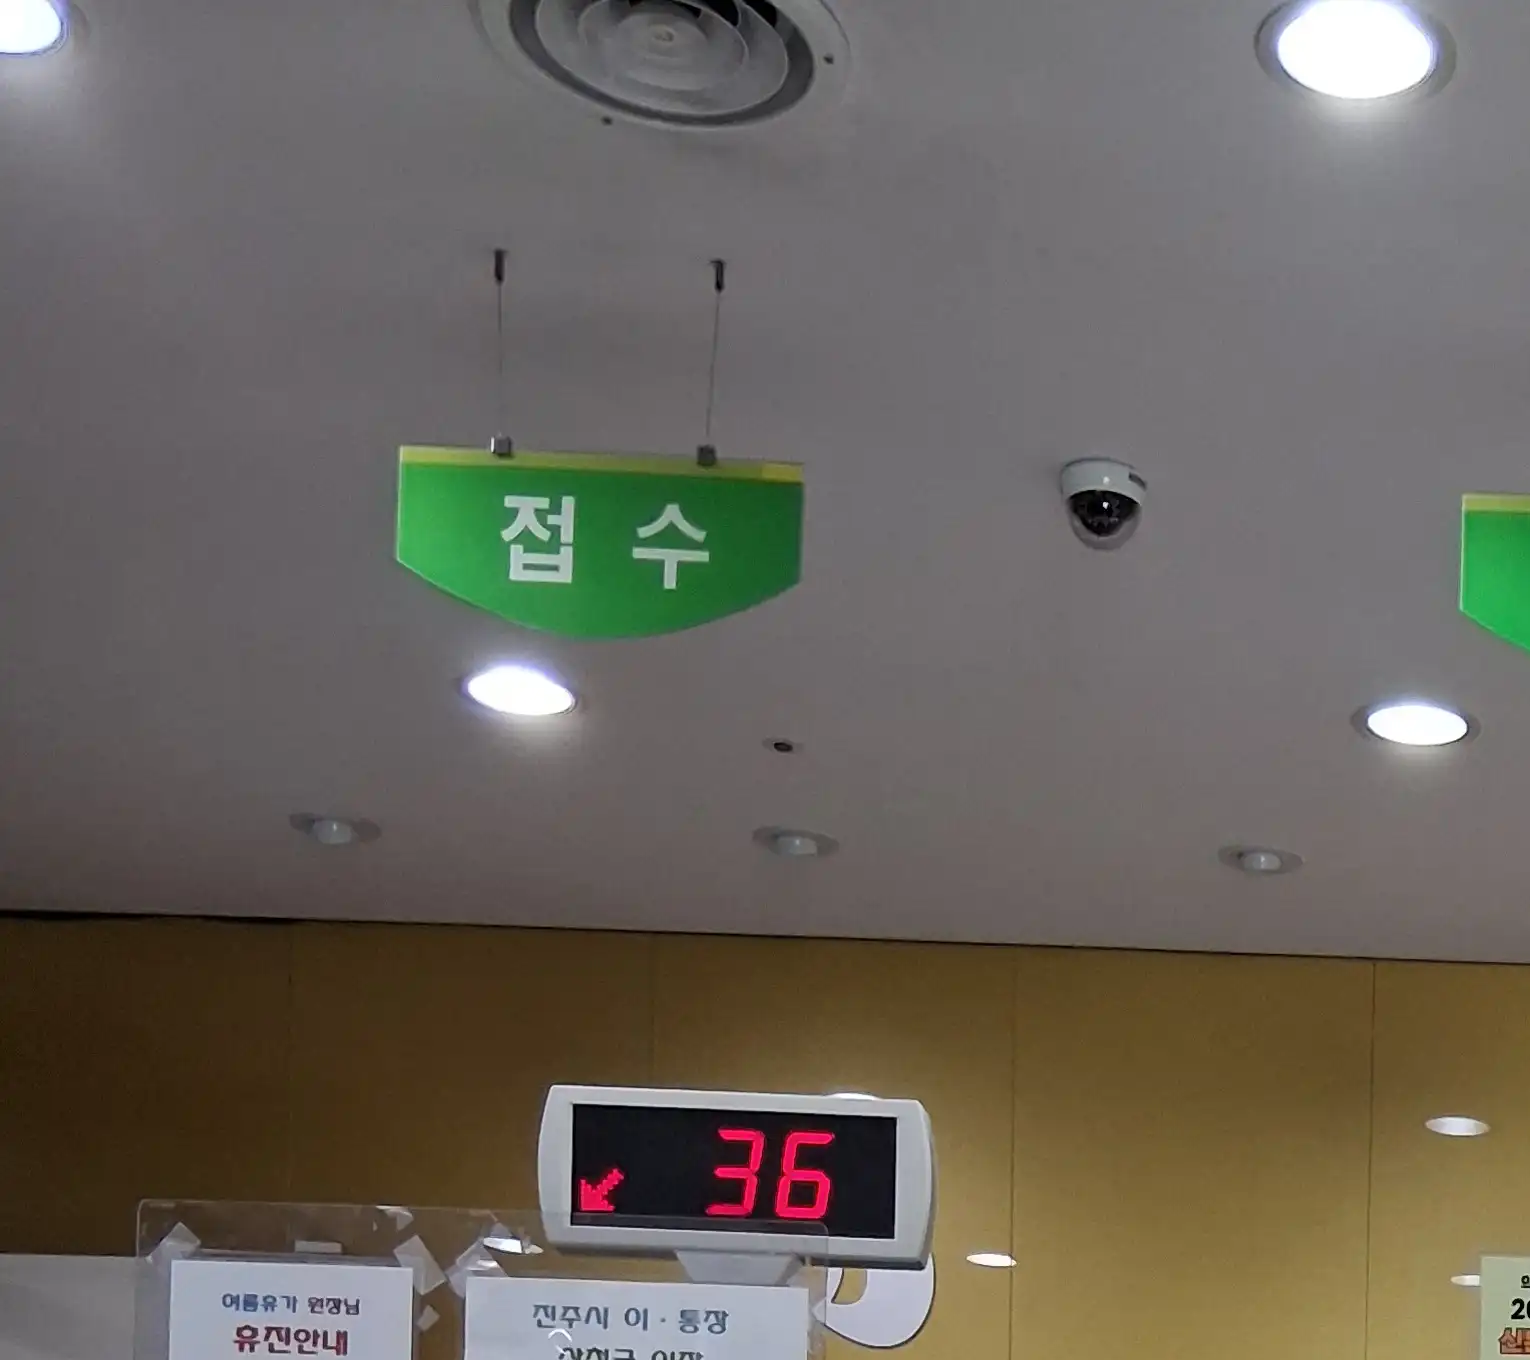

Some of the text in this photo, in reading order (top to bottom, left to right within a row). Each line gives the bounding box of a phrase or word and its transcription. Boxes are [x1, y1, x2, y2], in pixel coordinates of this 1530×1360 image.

[706, 1128, 835, 1220] 36
[308, 1296, 360, 1315] 원장님
[533, 1304, 609, 1329] 진주시
[234, 1325, 348, 1356] 휴진안내
